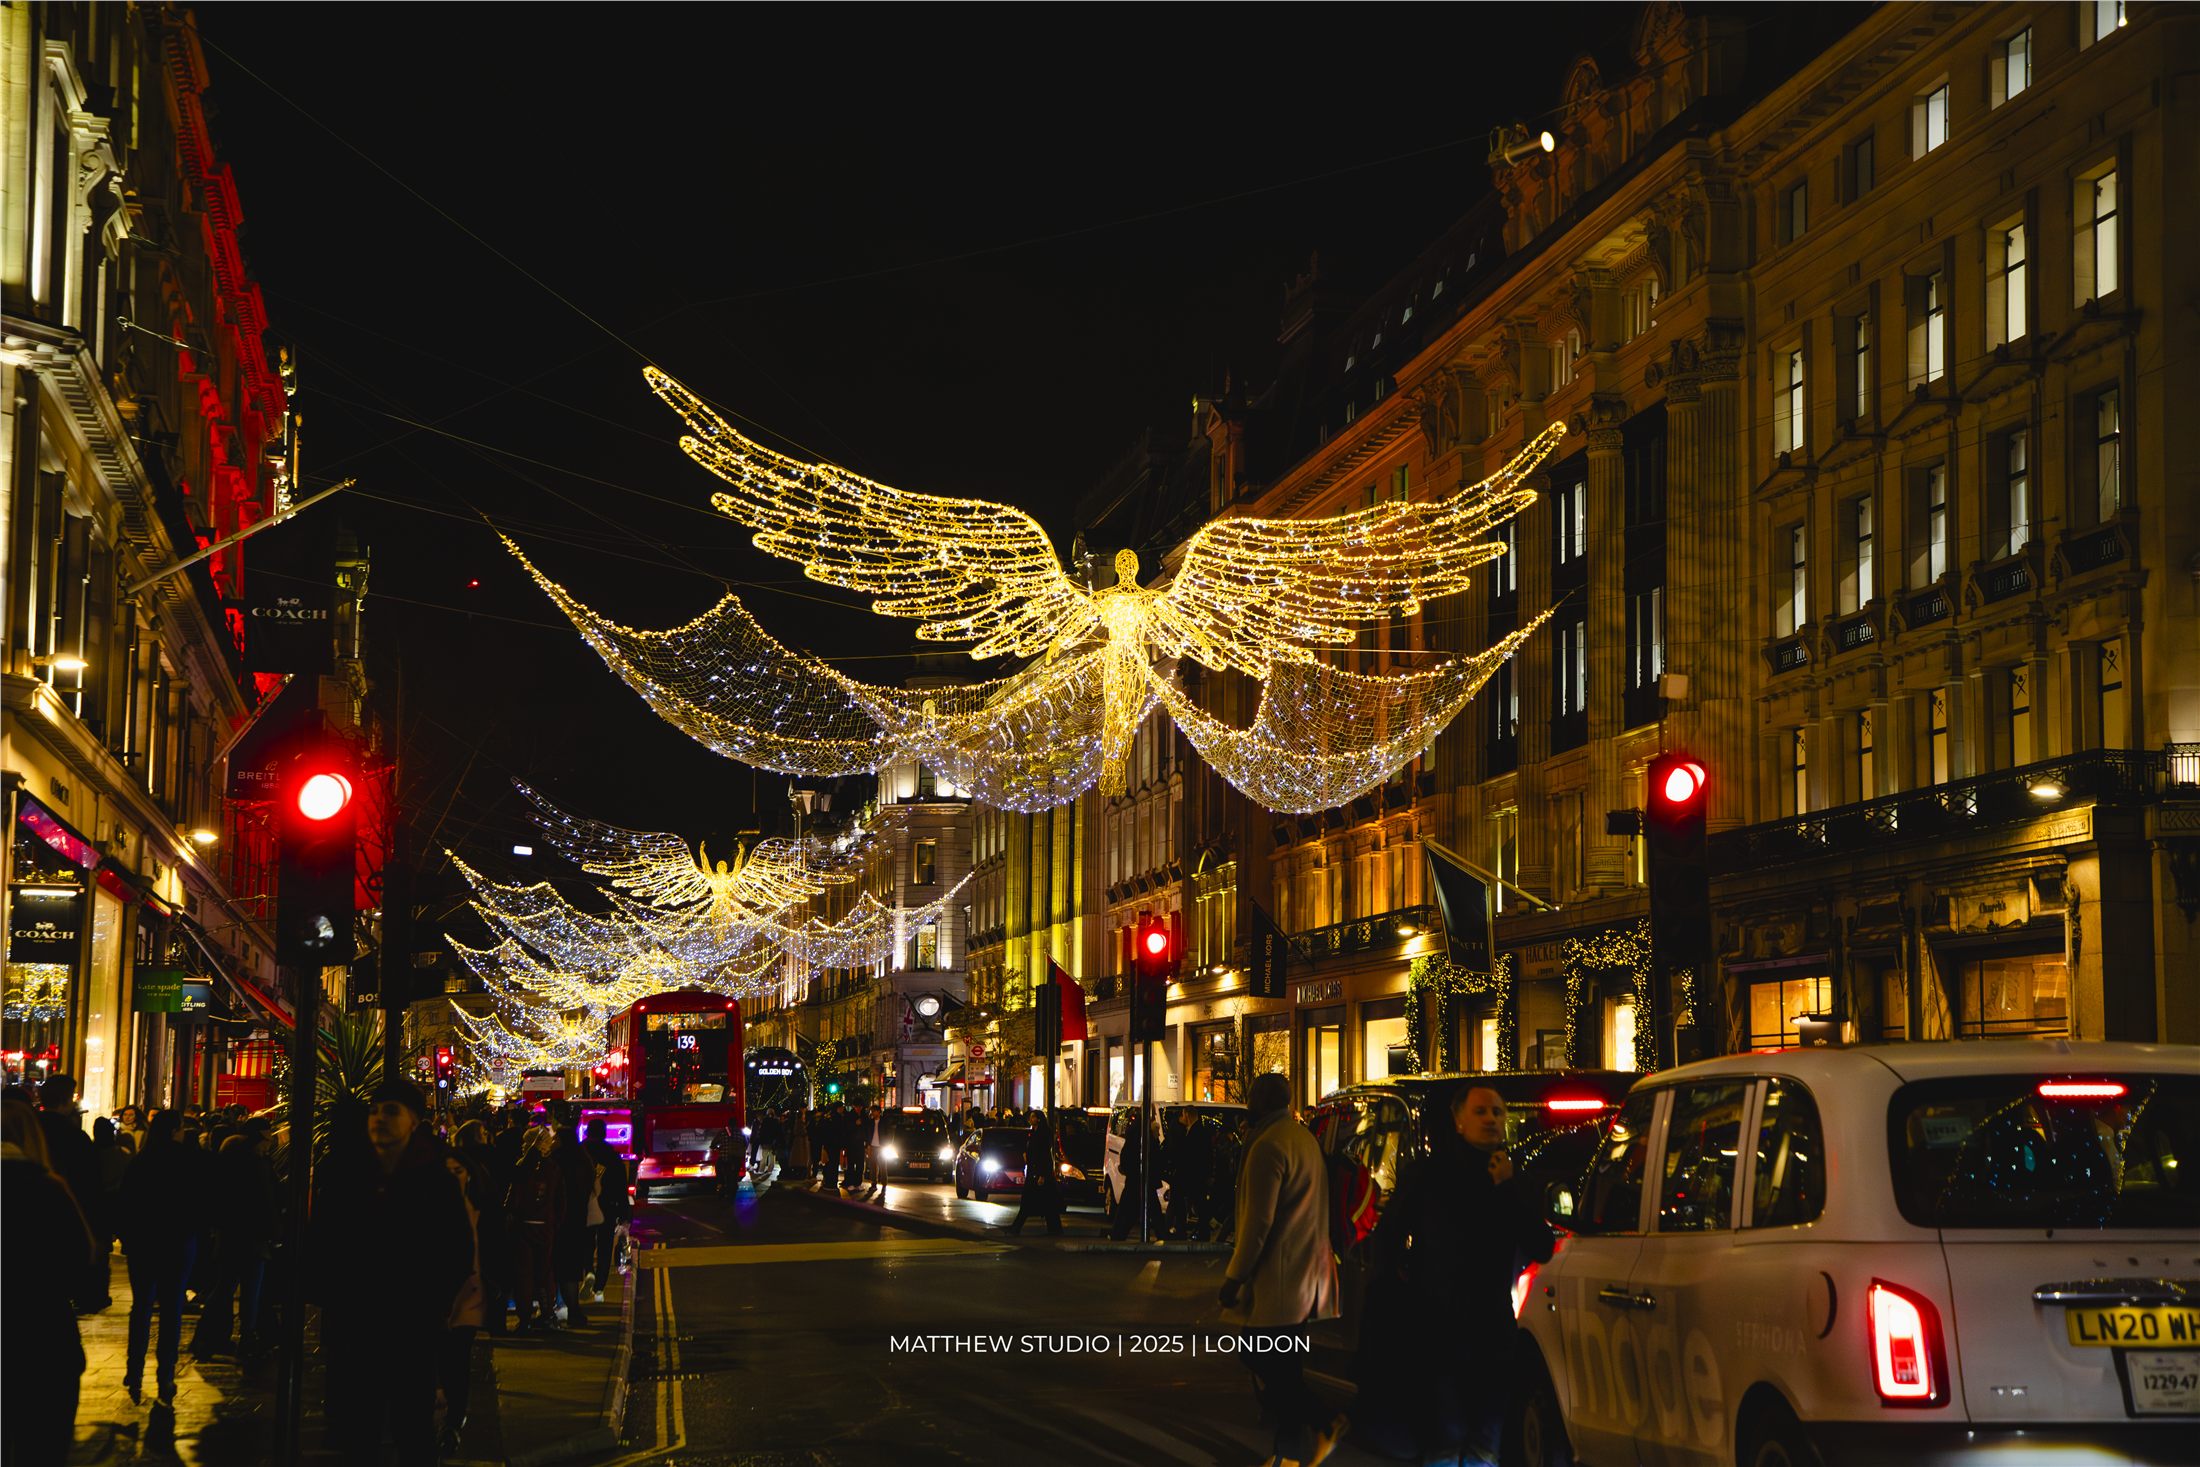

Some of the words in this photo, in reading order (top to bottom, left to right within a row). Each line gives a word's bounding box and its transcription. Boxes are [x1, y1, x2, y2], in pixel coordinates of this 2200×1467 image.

[251, 607, 328, 620] COACH
[237, 770, 281, 781] BREITL
[14, 929, 75, 940] COACH
[1265, 934, 1273, 957] KORS
[1264, 959, 1272, 993] MICHAEL
[157, 984, 181, 993] spade
[1296, 982, 1323, 1004] MICHAEL
[357, 993, 381, 1004] BOS
[677, 1035, 697, 1049] 139
[418, 1059, 430, 1067] 20
[758, 1068, 781, 1076] GOLDEN
[781, 1068, 793, 1076] BOY
[2077, 1312, 2159, 1341] LN20
